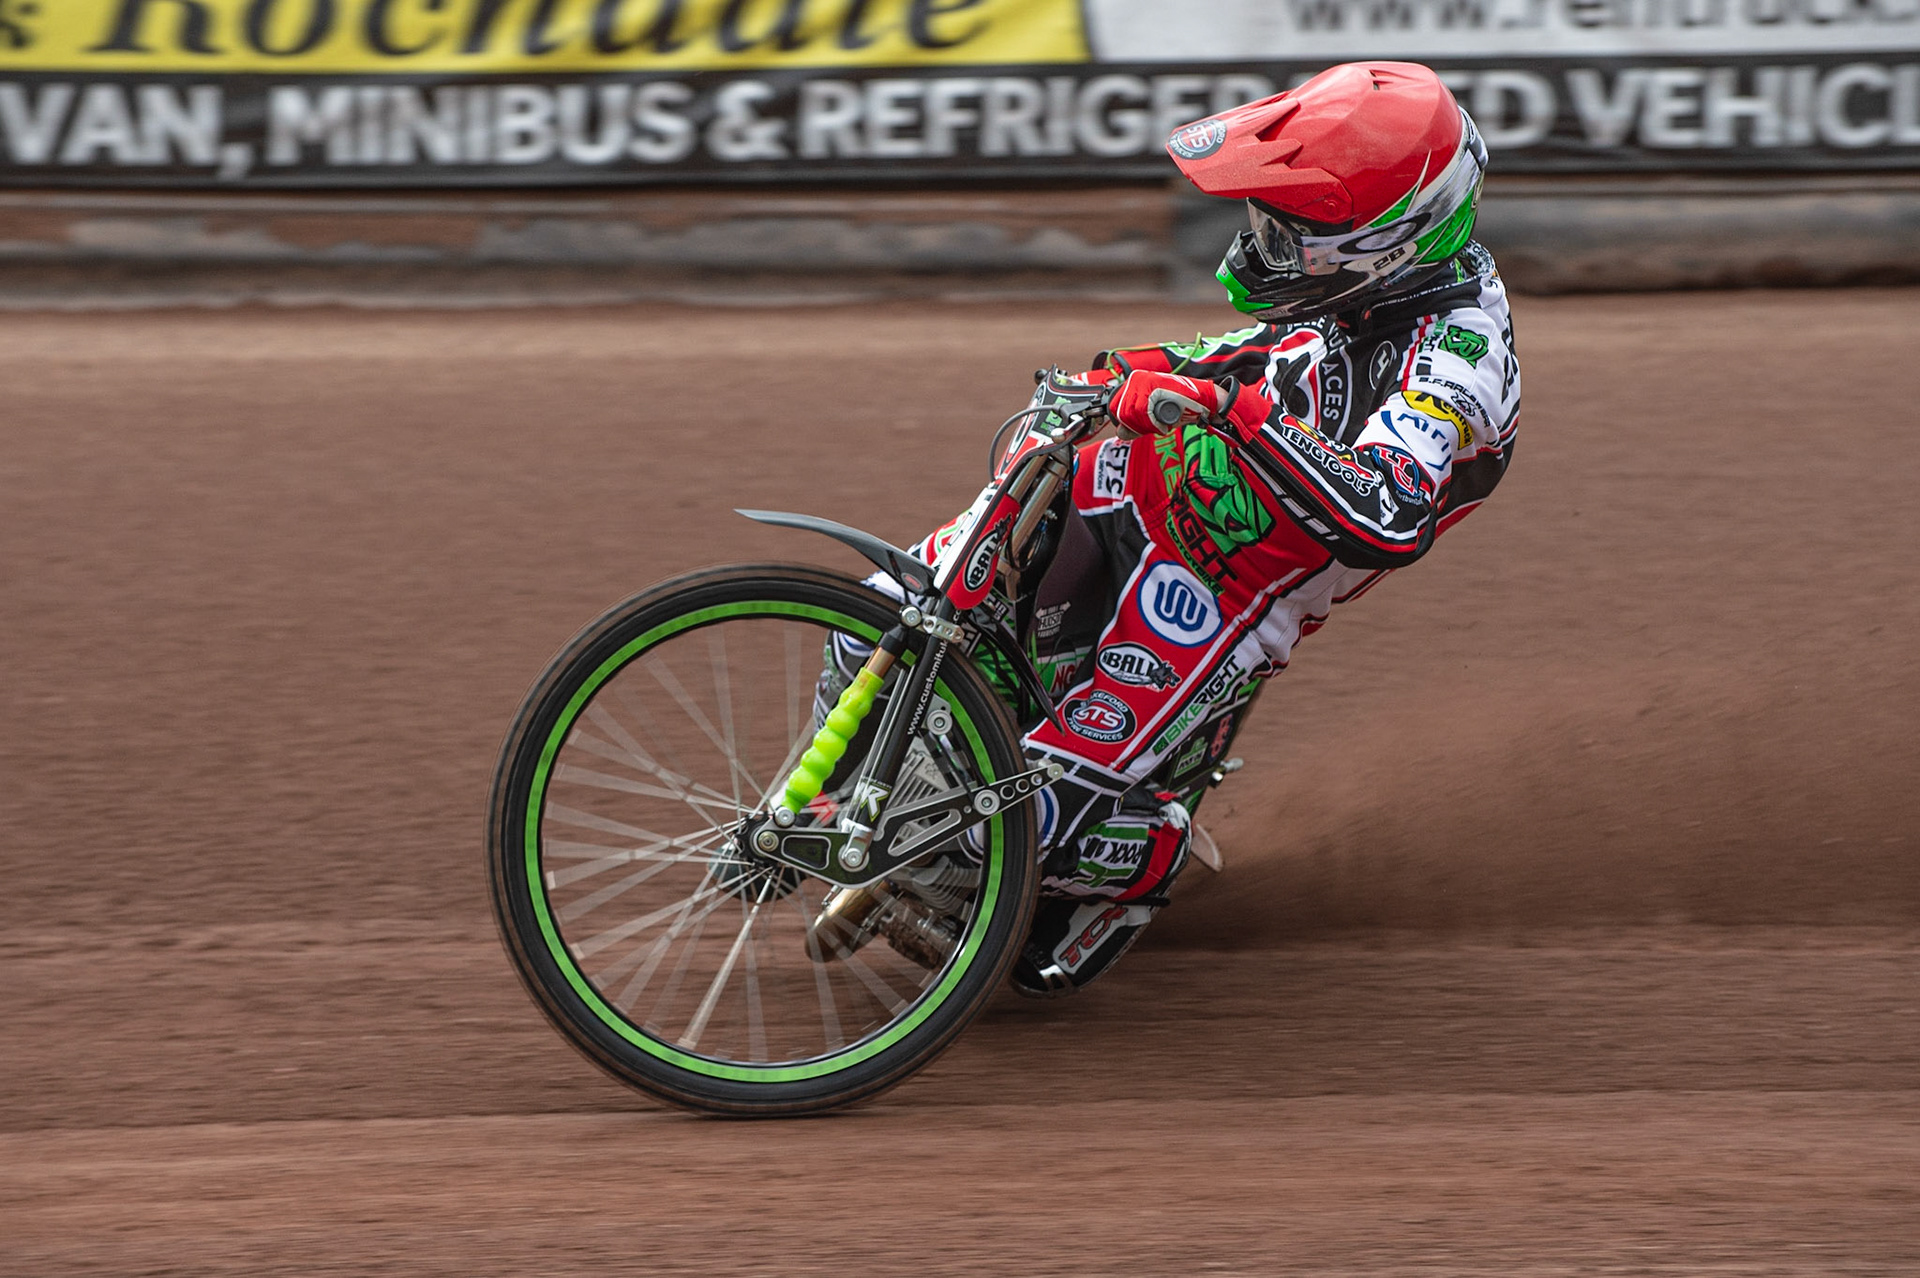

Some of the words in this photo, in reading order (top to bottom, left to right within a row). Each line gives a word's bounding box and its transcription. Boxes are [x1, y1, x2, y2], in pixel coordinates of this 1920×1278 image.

[0, 82, 253, 181] VAN,
[266, 82, 696, 167] MINIBUS
[706, 79, 792, 164] &
[1320, 362, 1344, 420] ACES
